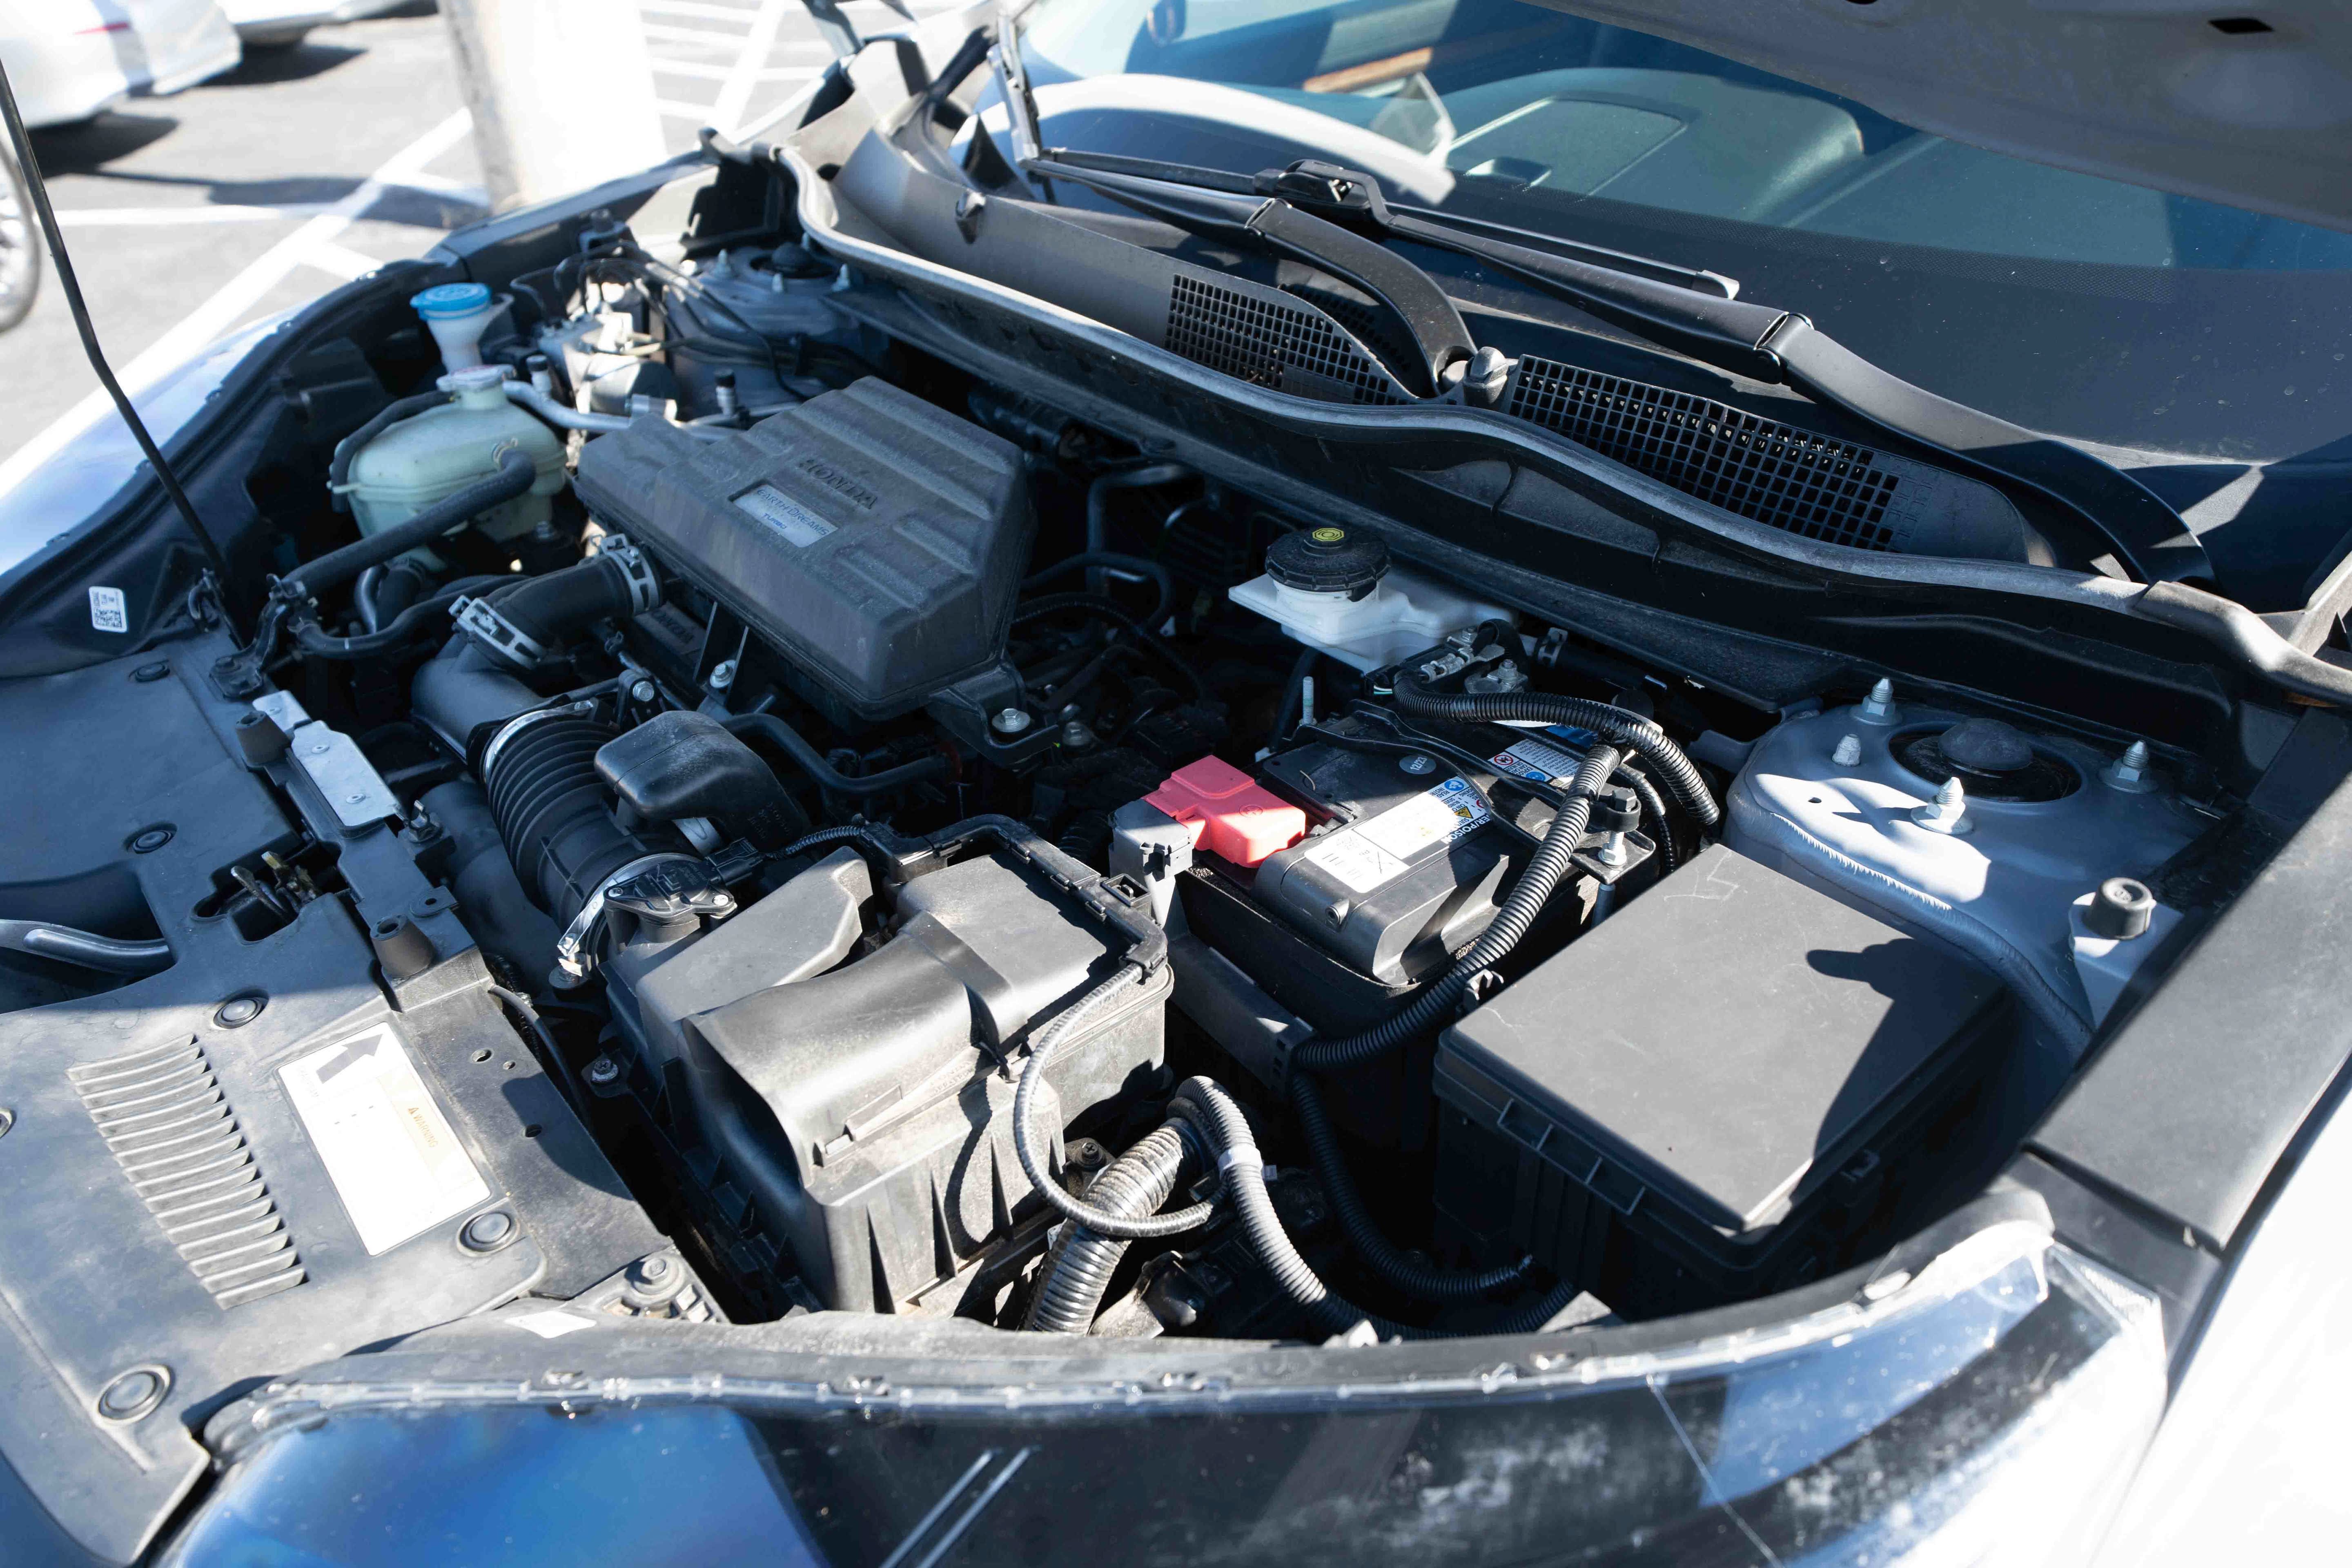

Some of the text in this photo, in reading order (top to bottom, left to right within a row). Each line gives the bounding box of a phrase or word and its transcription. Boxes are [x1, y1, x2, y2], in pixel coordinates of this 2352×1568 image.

[799, 459, 878, 510] HONDA
[757, 490, 830, 536] EARTH DREAMS
[762, 512, 787, 530] TURBO
[1410, 757, 1428, 770] 12/23
[1441, 815, 1490, 844] ER/POISON
[413, 1114, 438, 1147] WARNING
